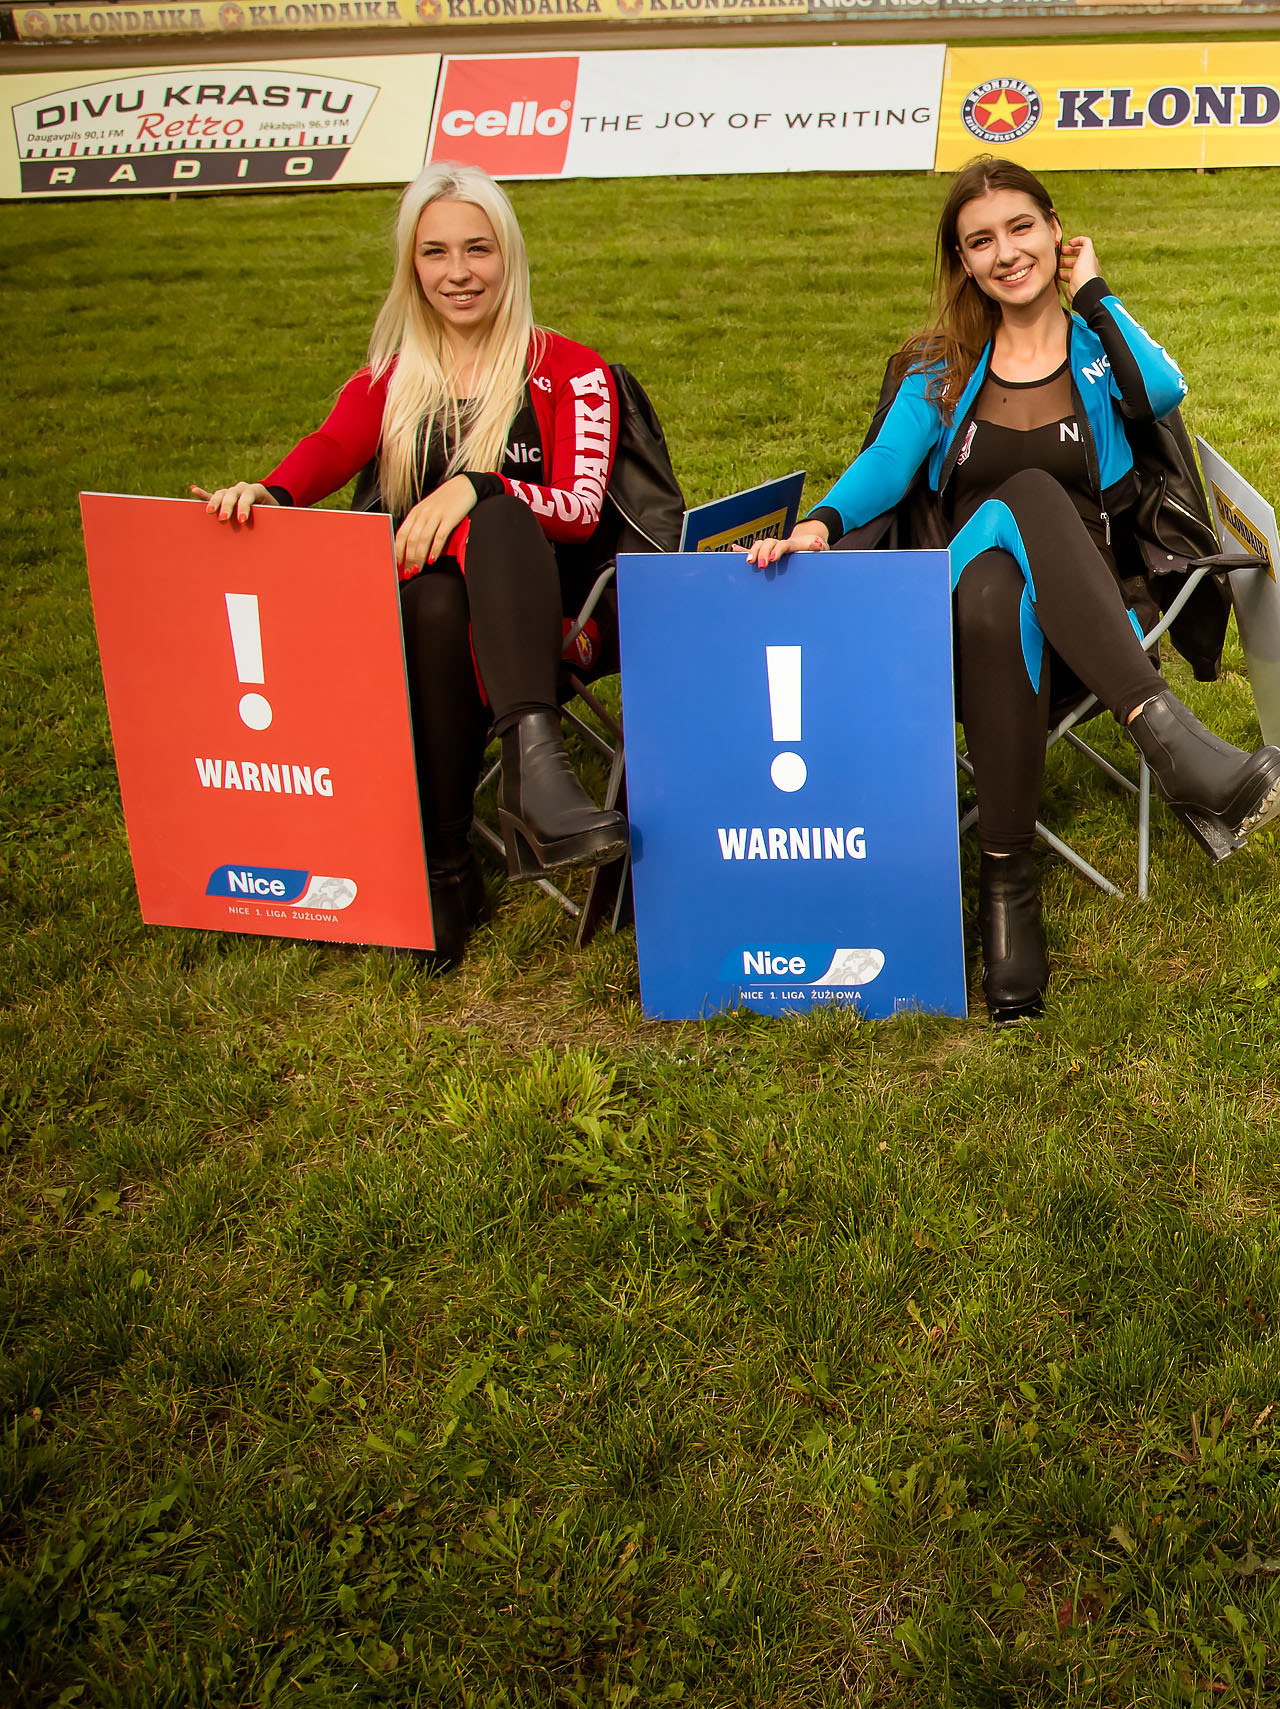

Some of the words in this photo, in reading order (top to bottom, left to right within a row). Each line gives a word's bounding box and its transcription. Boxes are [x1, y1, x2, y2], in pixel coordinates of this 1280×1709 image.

[54, 9, 204, 33] KLONDAIKA
[250, 0, 401, 26] KLONDAIKA
[448, 0, 602, 17] KLONDAIKA
[36, 89, 145, 130] DIVU
[163, 84, 354, 114] KRASTU
[441, 101, 569, 137] cello
[580, 114, 643, 133] THE
[655, 112, 716, 130] JOY
[727, 112, 772, 129] OF
[785, 107, 931, 129] WRITING
[136, 112, 244, 141] Retro
[333, 119, 350, 127] FM
[27, 132, 82, 144] Daugavpils
[108, 129, 124, 138] FM
[1081, 354, 1112, 385] Nic
[503, 442, 543, 464] Nic
[193, 757, 335, 797] WARNING
[717, 826, 868, 861] WARNING
[227, 870, 286, 897] Nice
[229, 906, 250, 916] NICE
[266, 910, 288, 919] LIGA
[292, 910, 339, 923] ŻUŻLOWA
[743, 950, 807, 976] Nice
[741, 991, 764, 1000] NICE
[782, 991, 805, 1000] LIGA
